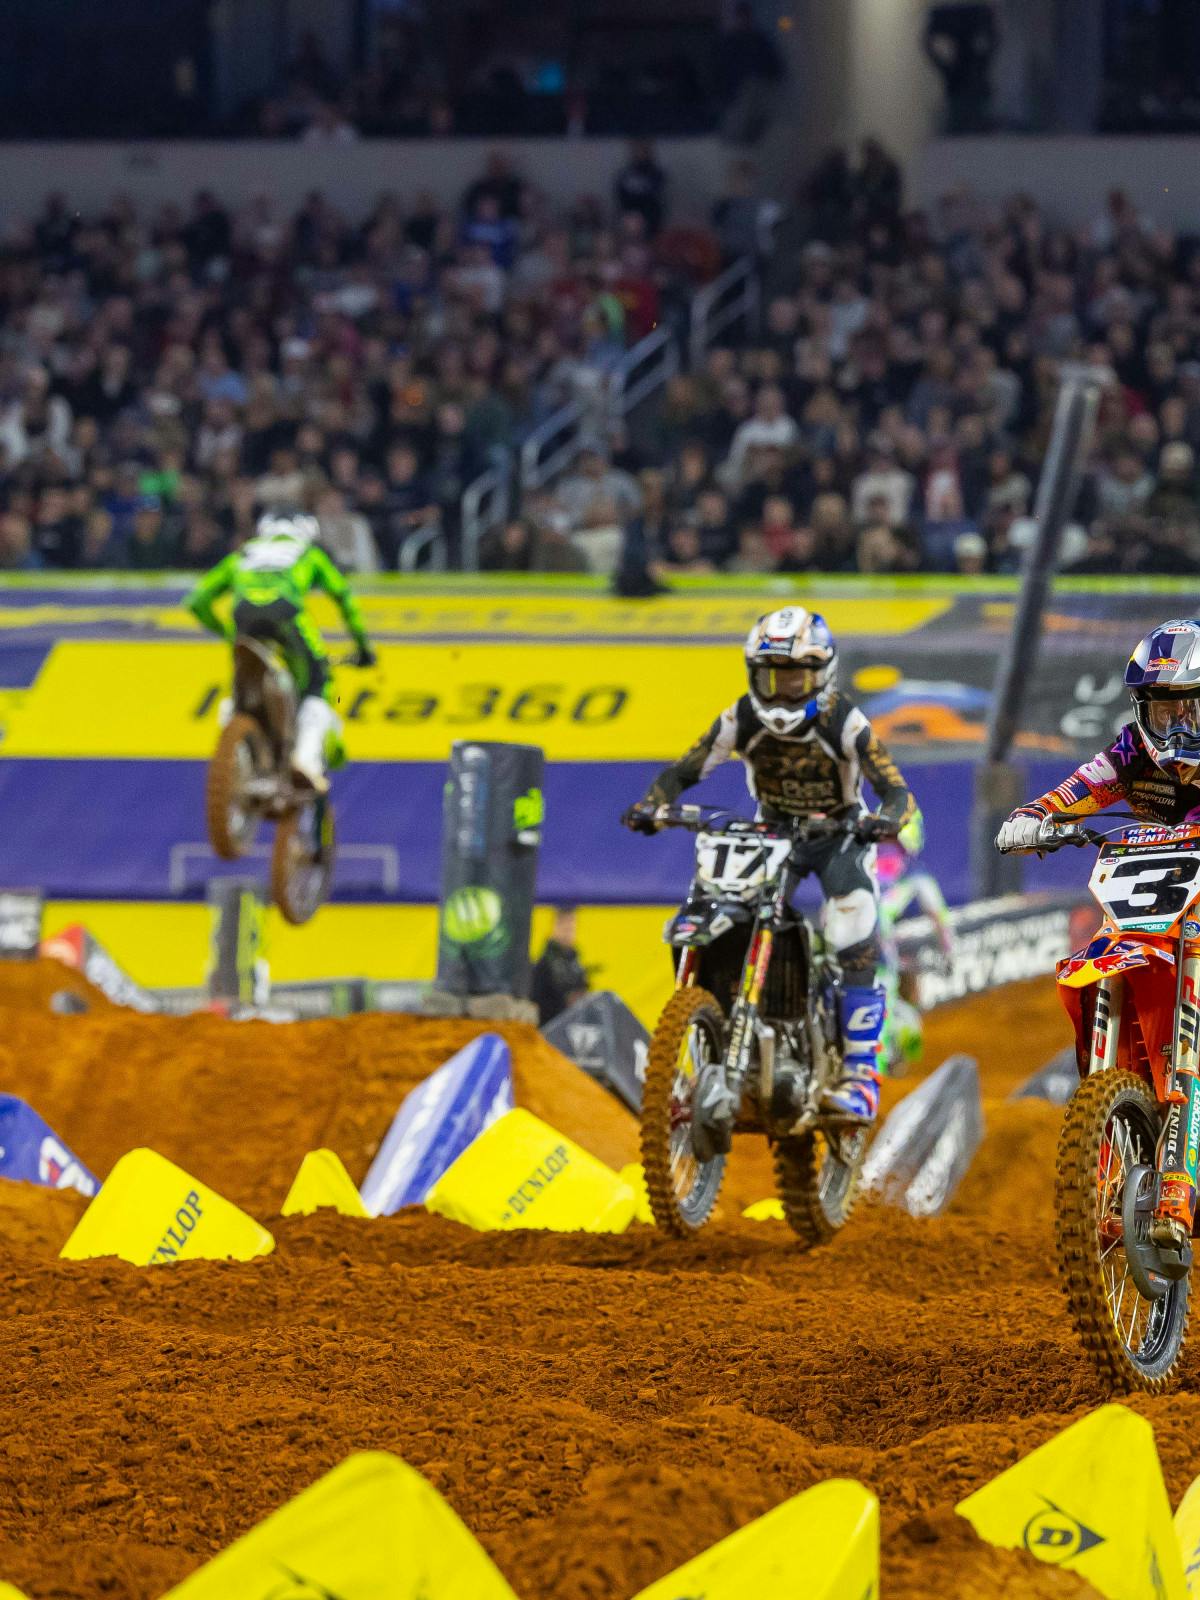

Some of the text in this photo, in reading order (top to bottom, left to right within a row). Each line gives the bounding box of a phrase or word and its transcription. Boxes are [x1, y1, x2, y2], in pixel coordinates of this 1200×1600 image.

[193, 682, 630, 727] Ita360
[713, 844, 774, 879] 17
[1167, 1080, 1183, 1153] DUNLP
[507, 1145, 569, 1214] DUNLOP
[1035, 1527, 1074, 1546] D
